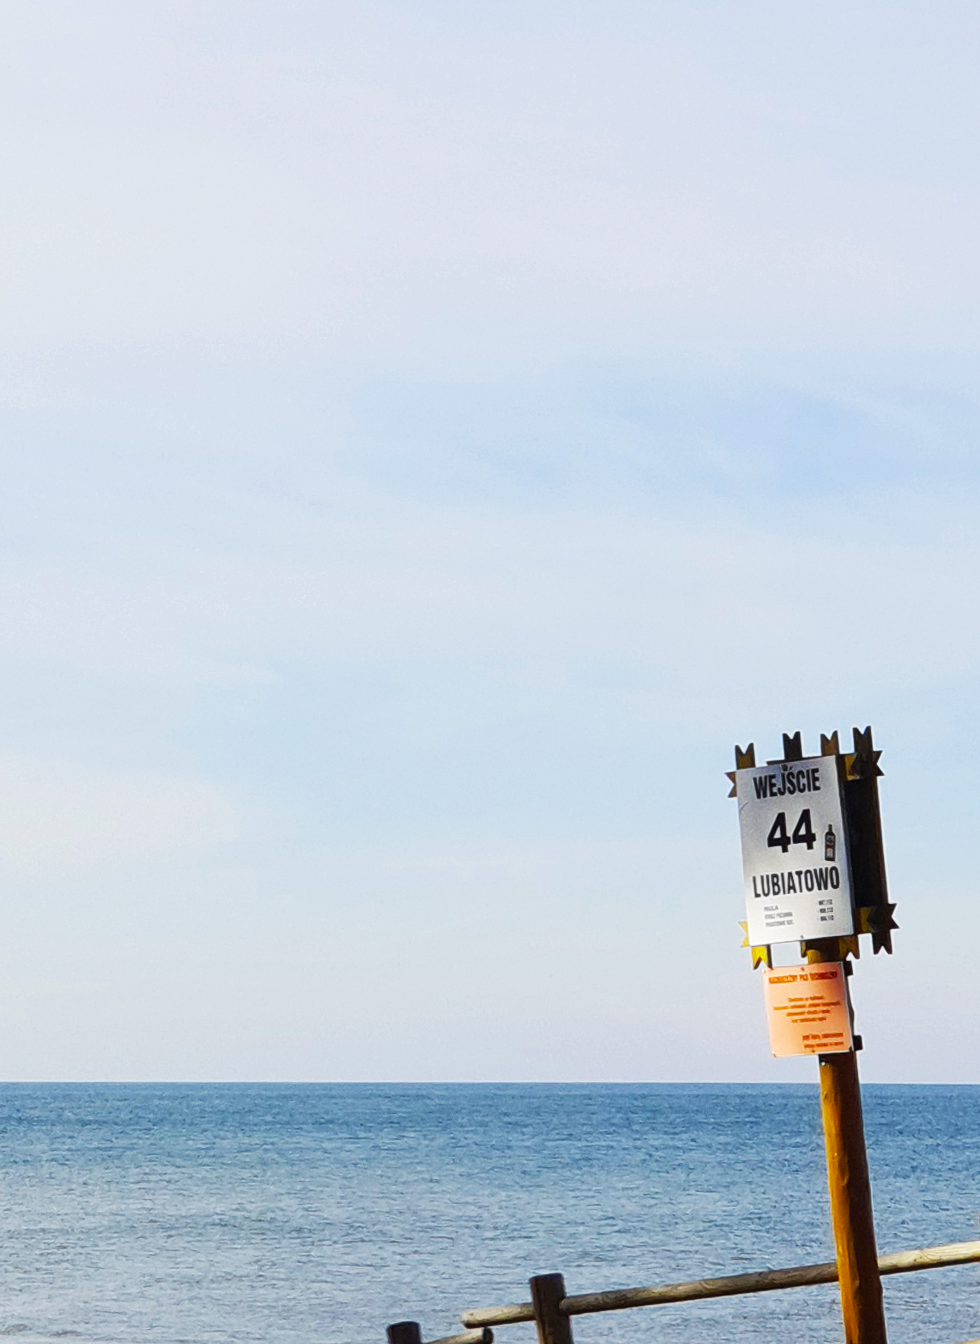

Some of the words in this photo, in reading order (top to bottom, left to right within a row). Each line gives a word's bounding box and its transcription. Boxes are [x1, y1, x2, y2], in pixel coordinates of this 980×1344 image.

[753, 766, 821, 799] WEJŚCIE
[767, 808, 816, 853] 44
[752, 866, 840, 898] LUBIATOWO
